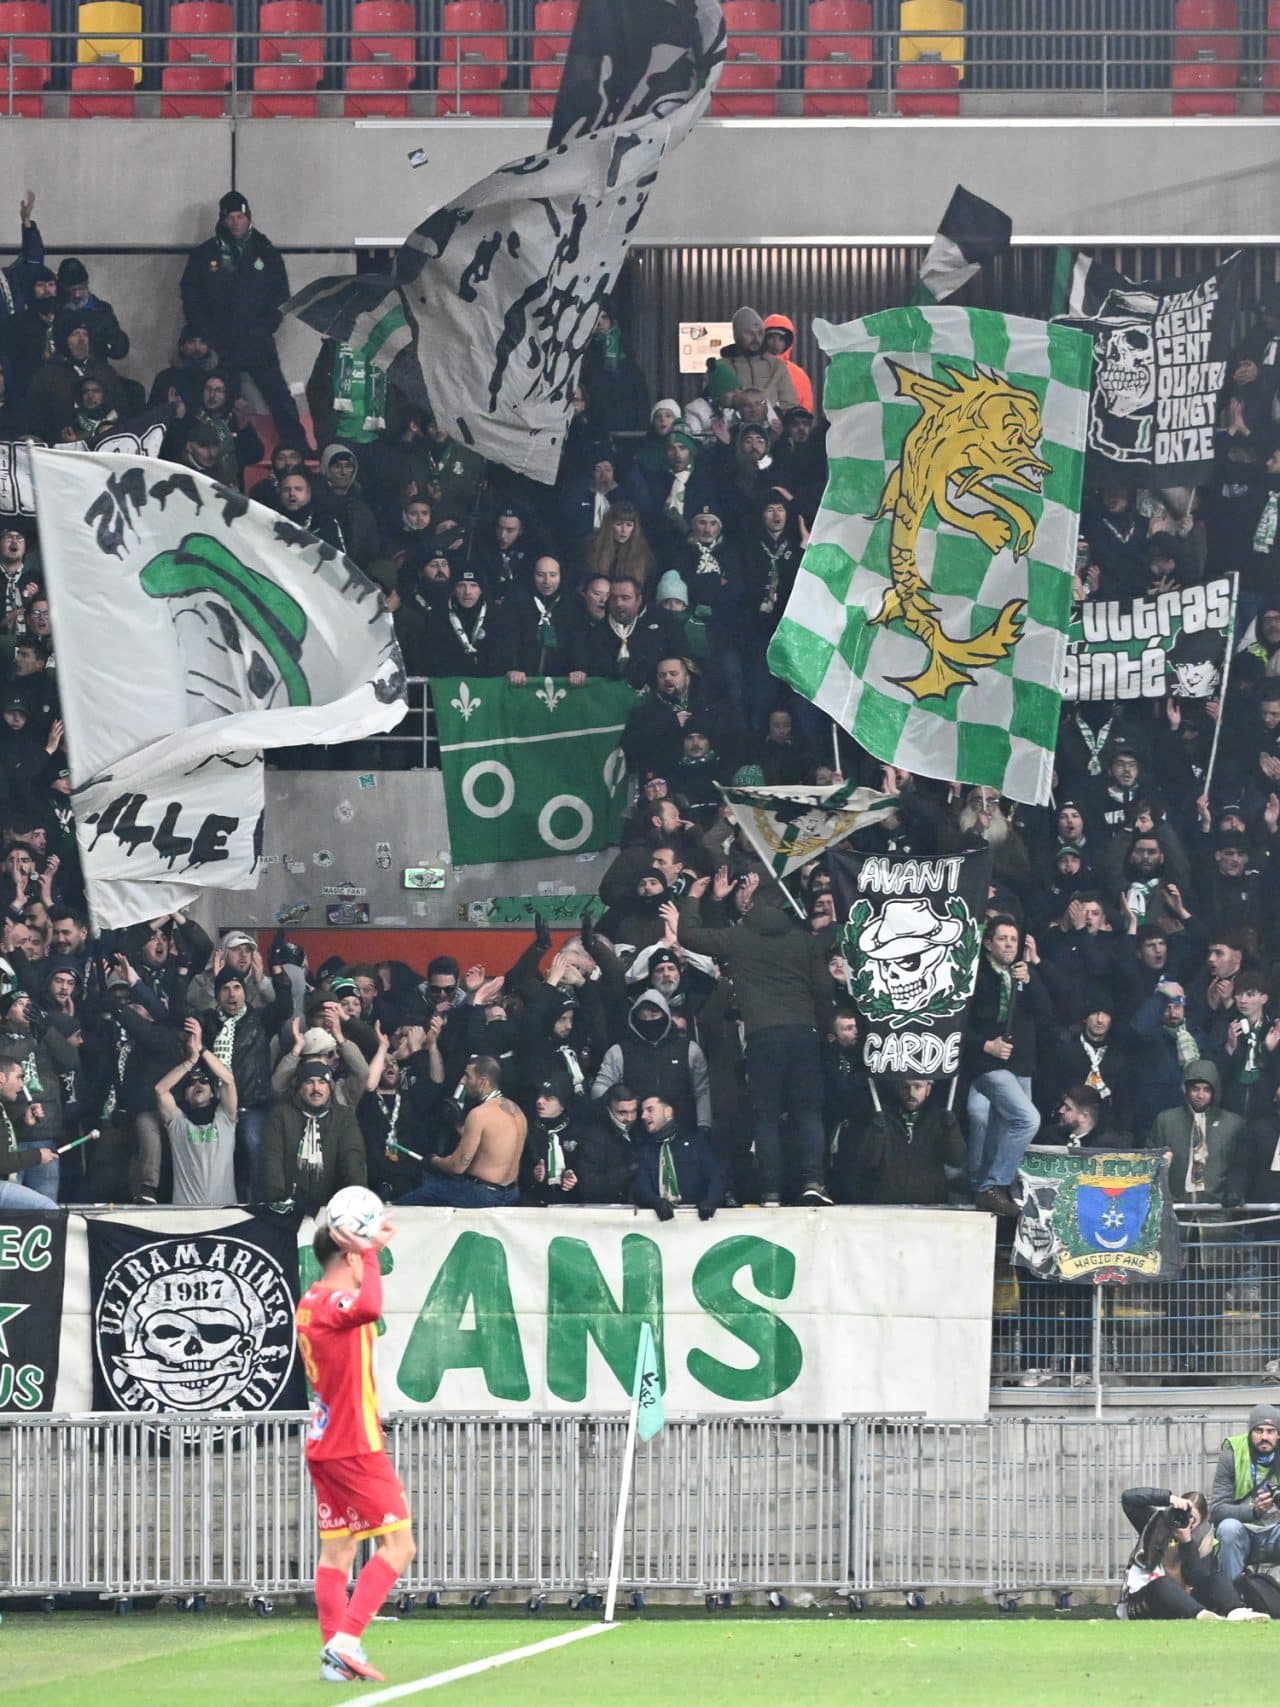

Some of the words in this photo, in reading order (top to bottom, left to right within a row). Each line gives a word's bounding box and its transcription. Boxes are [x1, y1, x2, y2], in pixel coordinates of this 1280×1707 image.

[1155, 302, 1215, 340] NEUF
[1156, 331, 1213, 367] CENT
[1157, 393, 1218, 431] VINGT
[1154, 427, 1216, 465] ONZE
[1082, 578, 1231, 643] ultras
[1062, 635, 1167, 701] ainté
[857, 856, 965, 894] AVANT
[863, 1031, 963, 1074] GARDE
[1022, 1155, 1096, 1177] CTION
[1074, 1253, 1112, 1269] MAGIC
[1115, 1254, 1146, 1269] FANS
[100, 1242, 289, 1337] ULTRAMARINES
[161, 1279, 224, 1303] 1987
